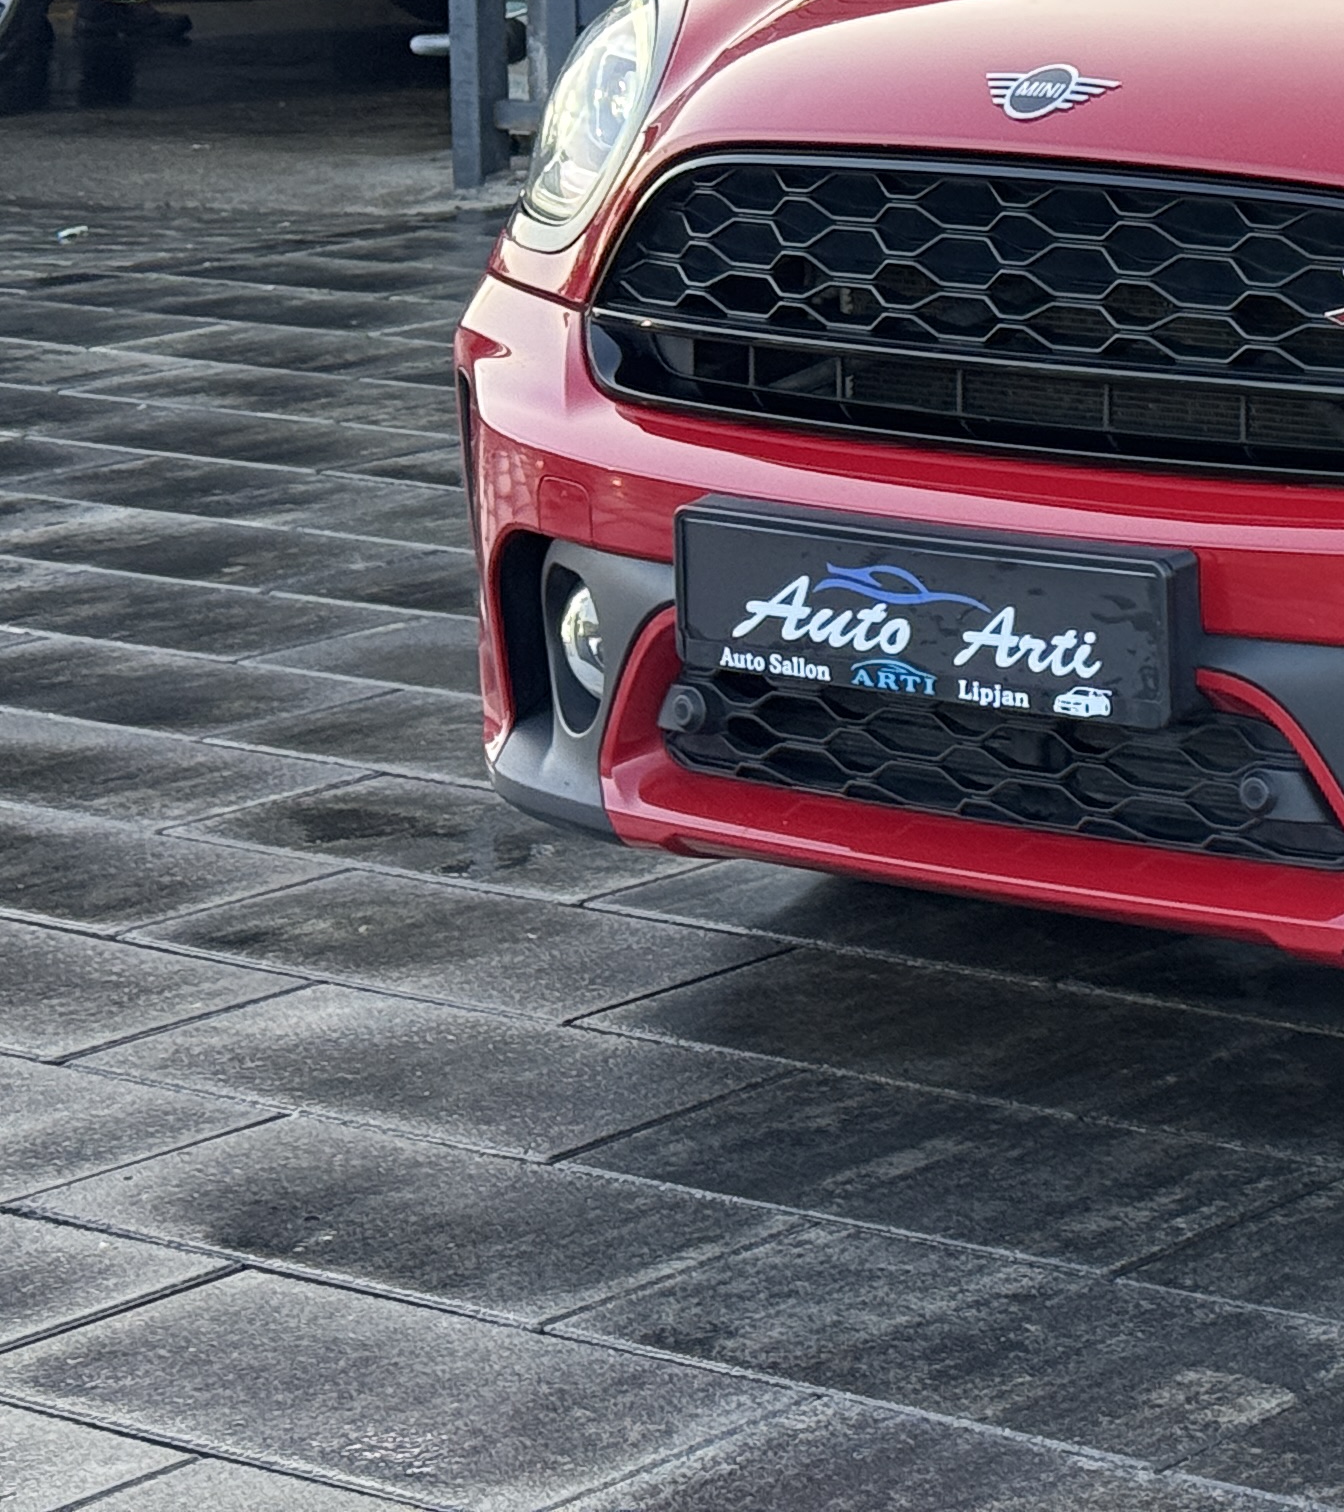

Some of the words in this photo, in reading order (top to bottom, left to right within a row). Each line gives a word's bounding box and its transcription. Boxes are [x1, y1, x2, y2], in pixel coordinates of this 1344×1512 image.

[1015, 80, 1067, 100] MINI
[732, 575, 912, 655] Auto
[953, 606, 1103, 679] Arti
[719, 646, 766, 673] Auto
[768, 652, 832, 683] Sallon
[851, 666, 937, 697] ARTI
[957, 678, 1031, 710] Lipjan
